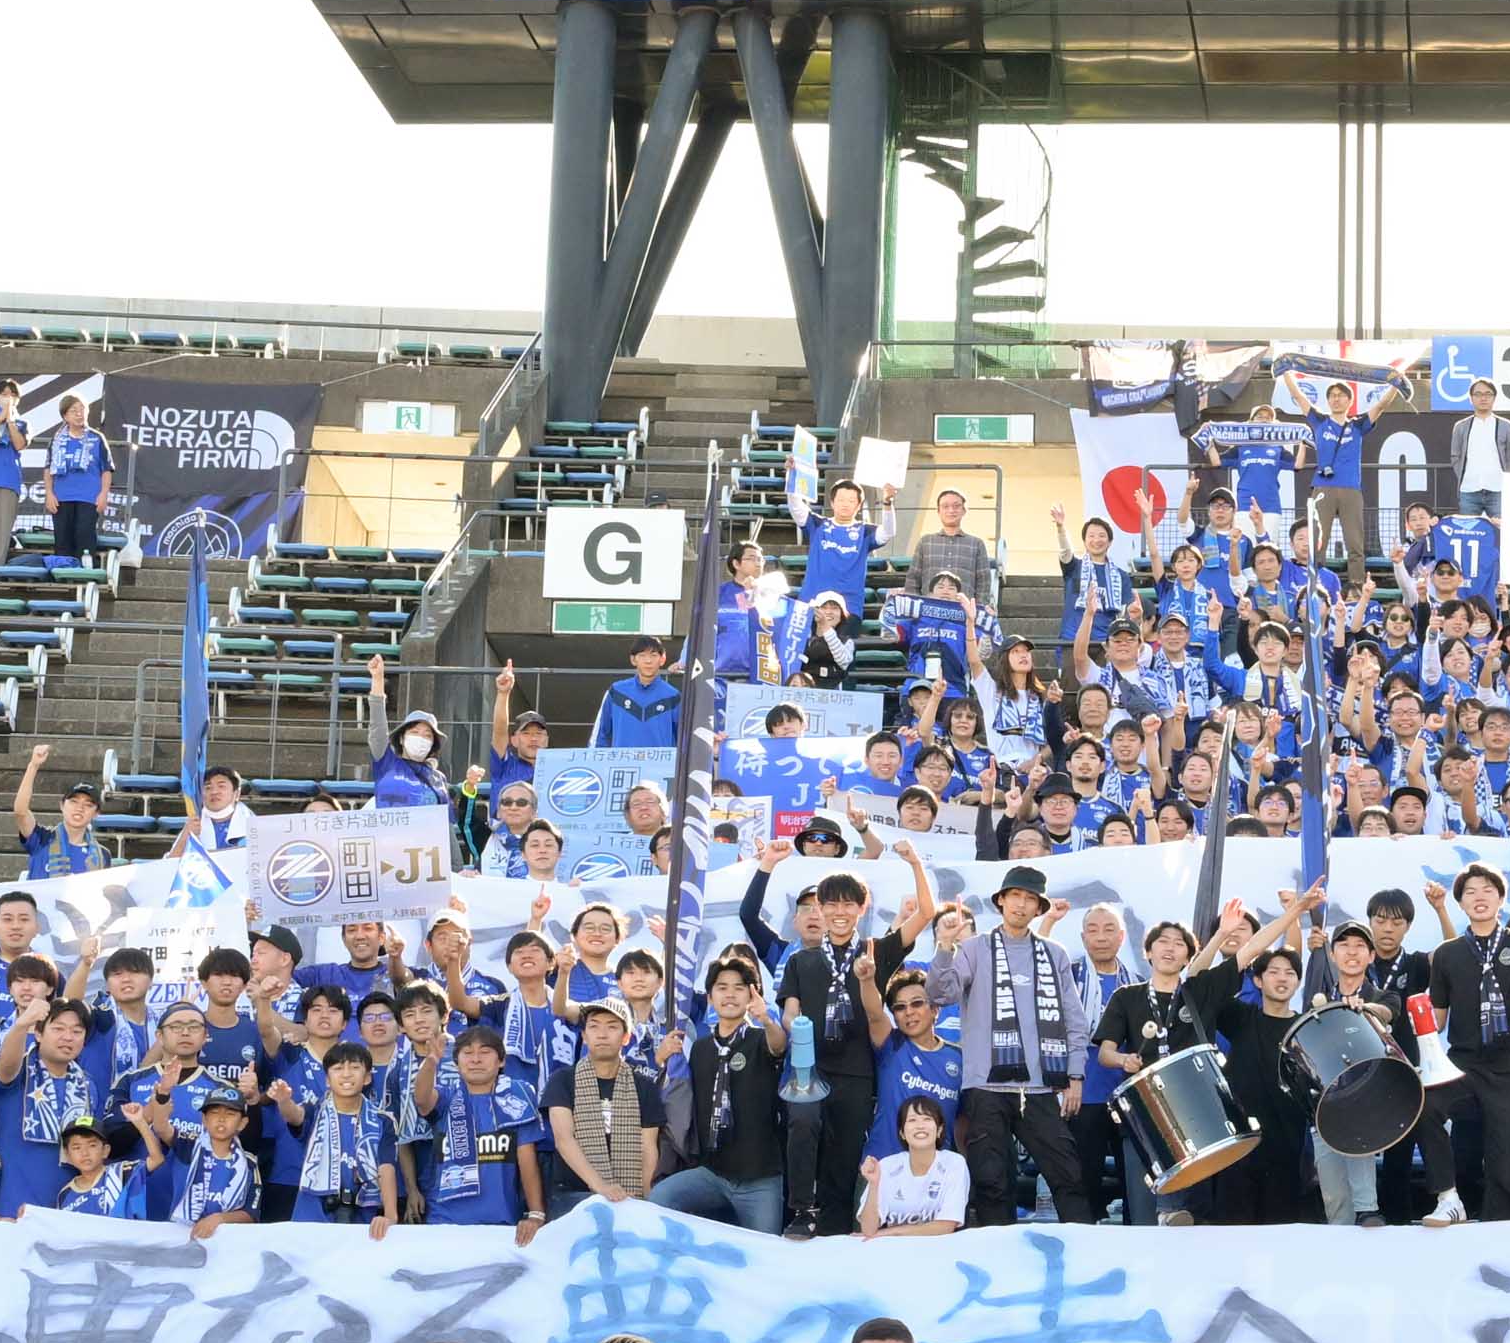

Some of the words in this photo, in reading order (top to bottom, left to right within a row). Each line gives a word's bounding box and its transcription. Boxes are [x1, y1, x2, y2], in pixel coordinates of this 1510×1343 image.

[140, 404, 252, 429] NOZUTA
[122, 424, 251, 449] TERRACE
[177, 447, 250, 469] FIRM
[583, 521, 644, 586] G
[282, 810, 412, 834] J1行き片道切符
[342, 840, 373, 900] 町田
[394, 845, 447, 885] J1
